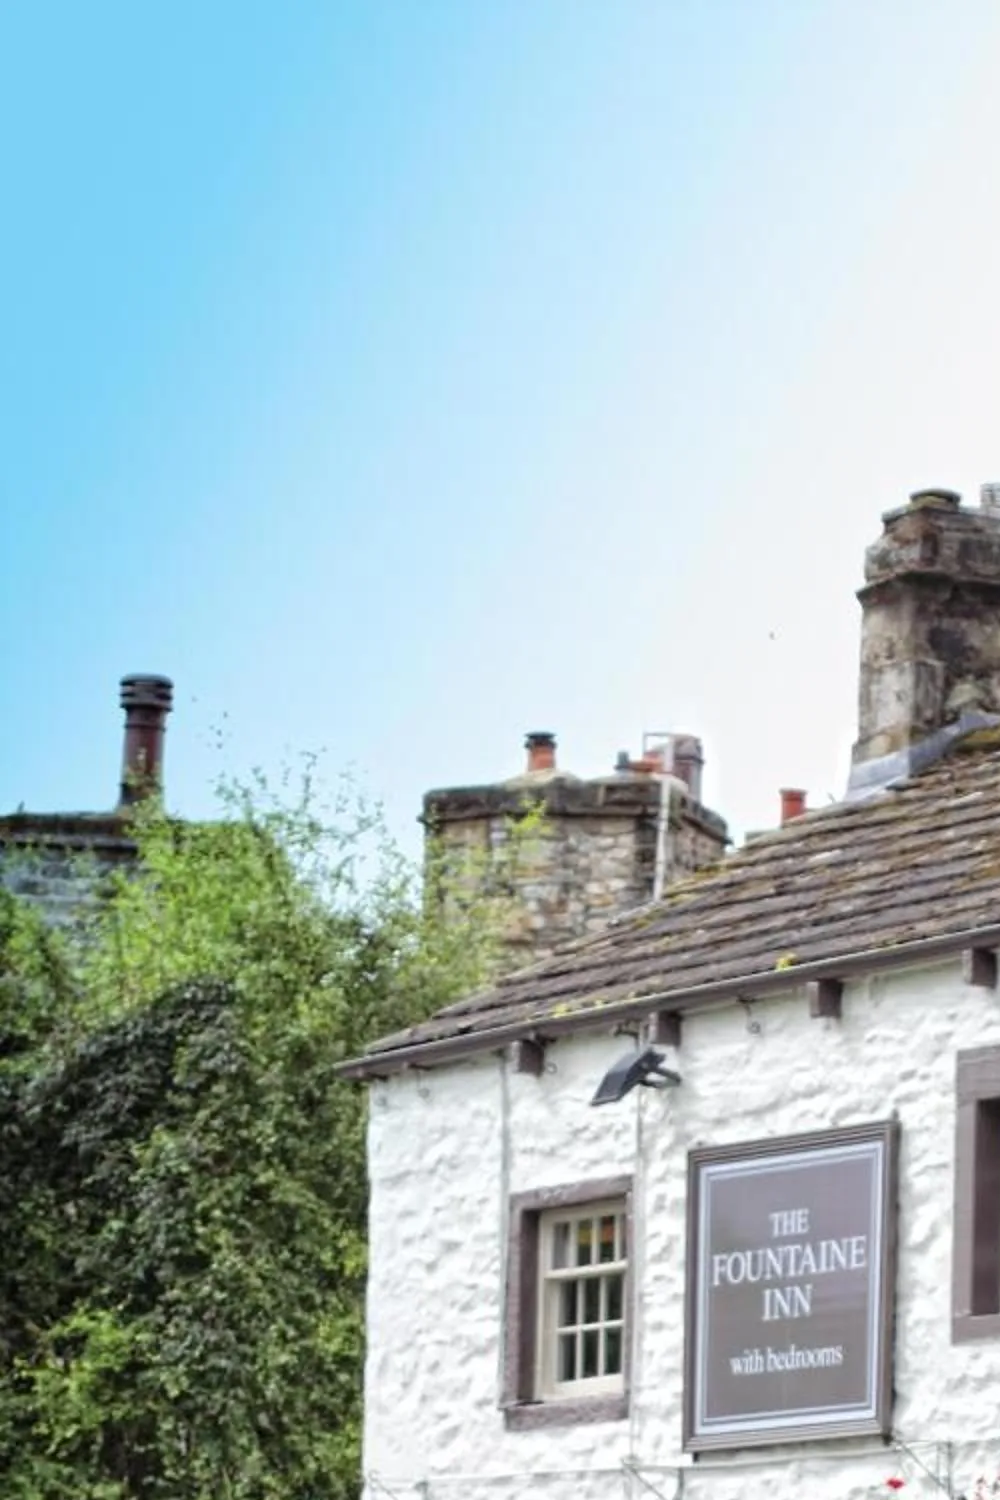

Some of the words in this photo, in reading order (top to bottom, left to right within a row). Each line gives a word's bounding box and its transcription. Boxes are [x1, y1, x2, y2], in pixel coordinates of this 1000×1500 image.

[769, 1208, 810, 1238] THE
[712, 1235, 867, 1287] FOUNTAINE
[762, 1283, 813, 1322] INN
[730, 1348, 764, 1375] with
[766, 1343, 843, 1372] bedrooms
